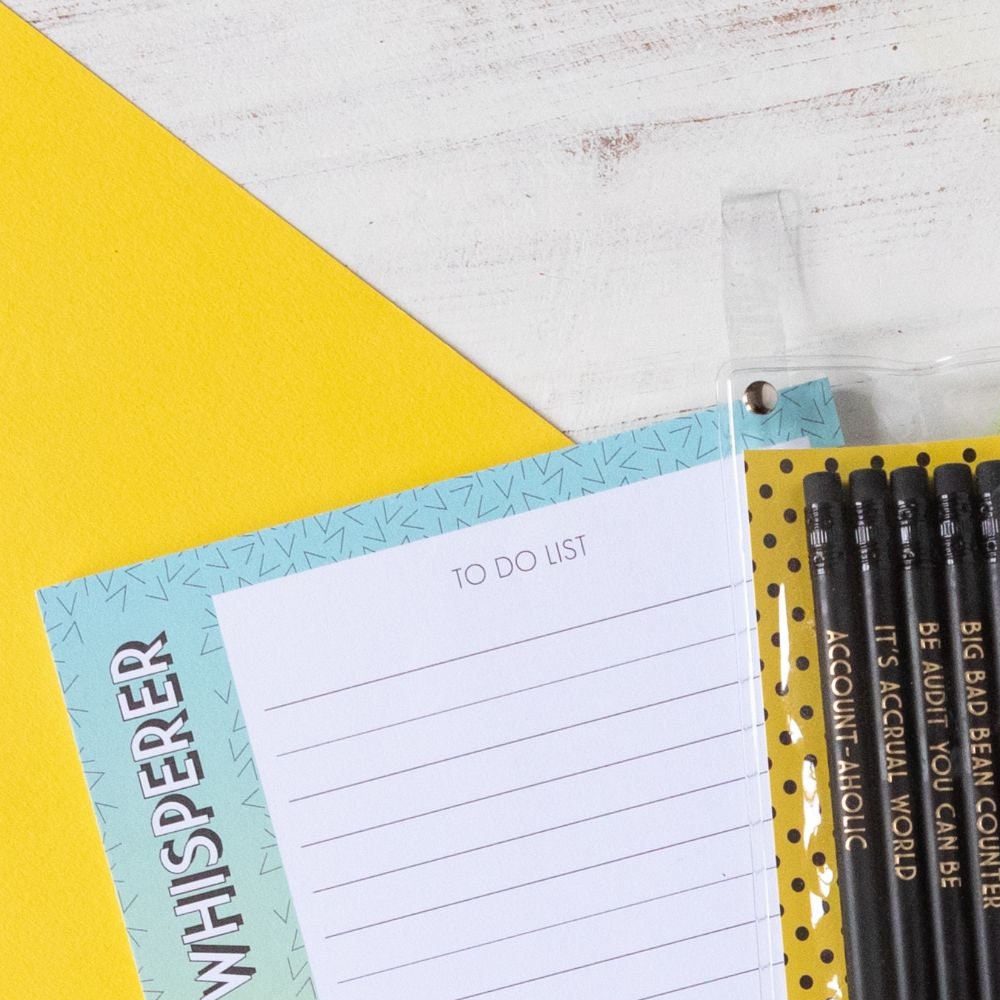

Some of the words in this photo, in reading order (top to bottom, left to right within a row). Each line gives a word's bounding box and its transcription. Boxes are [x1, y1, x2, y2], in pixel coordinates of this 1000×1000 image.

[452, 563, 487, 589] TO
[494, 550, 537, 579] DO
[545, 534, 586, 566] LIST
[874, 624, 899, 668] IT'S
[918, 622, 941, 650] BE
[960, 621, 984, 660] BIG
[922, 660, 948, 728] AUDIT
[965, 671, 988, 716] BAD
[826, 629, 868, 851] ACCOUNT-AHOLIC
[880, 680, 909, 784] ACCRUAL
[929, 742, 954, 792] YOU
[969, 728, 994, 787] BEAN
[890, 794, 917, 881] WORLD
[935, 803, 959, 850] CAN
[939, 861, 962, 889] BE
